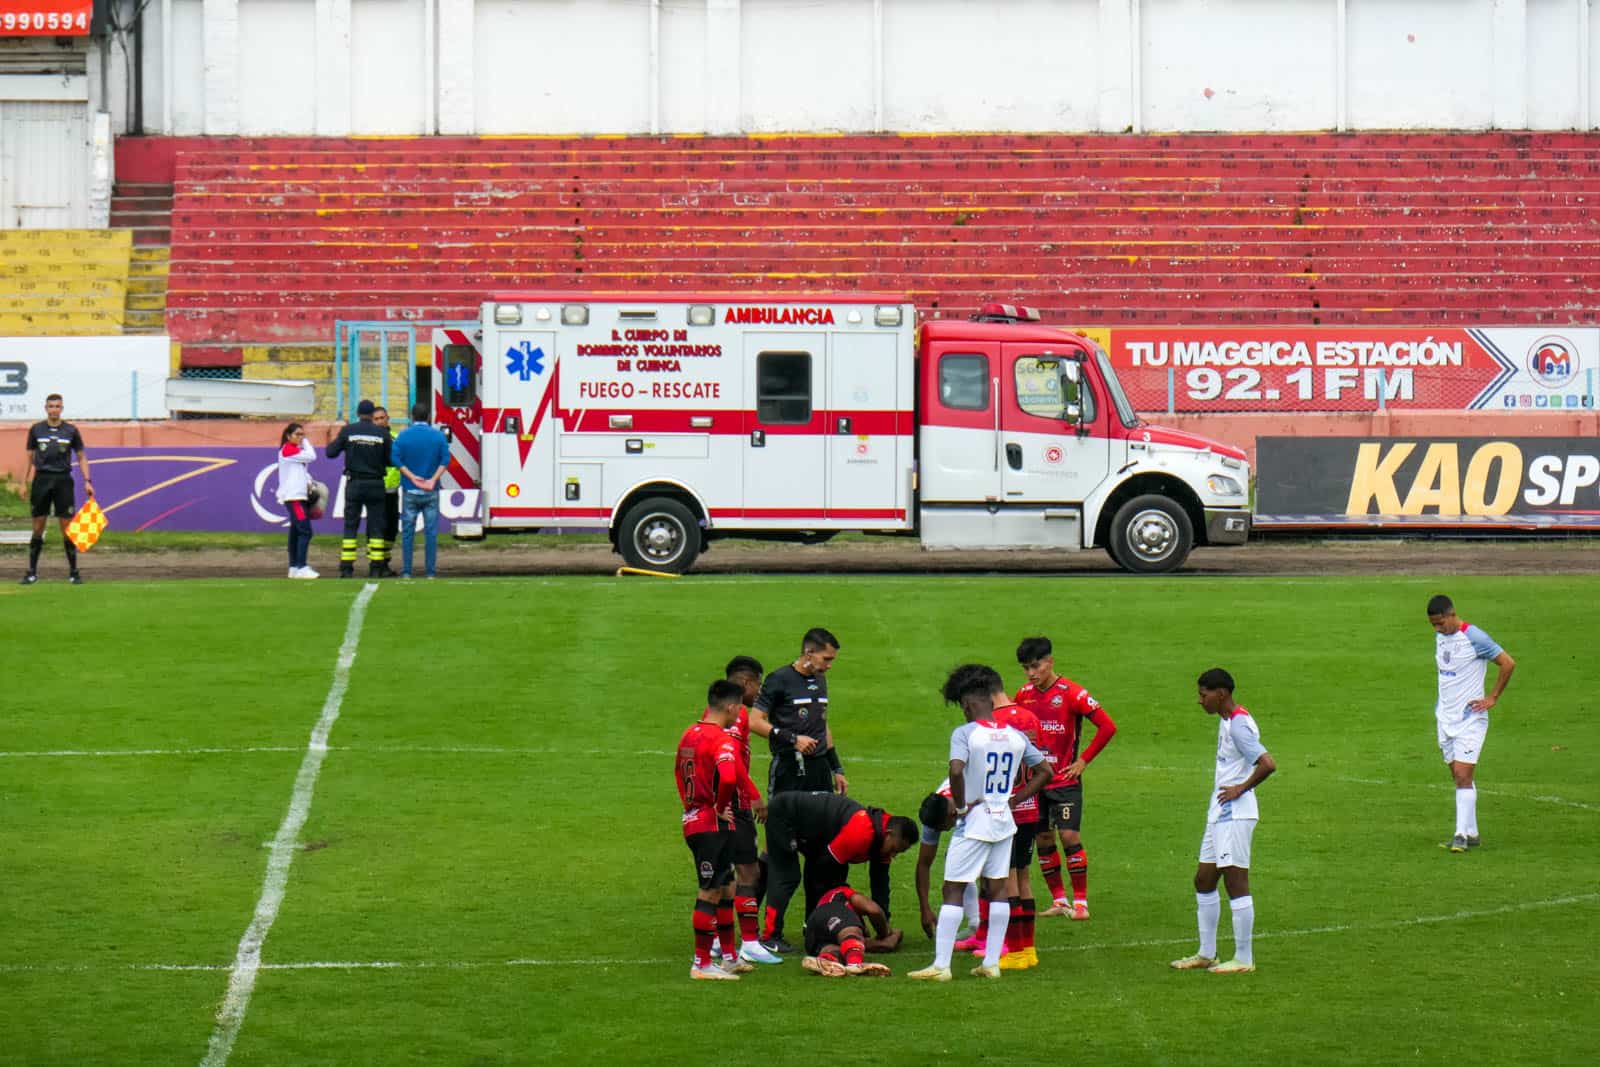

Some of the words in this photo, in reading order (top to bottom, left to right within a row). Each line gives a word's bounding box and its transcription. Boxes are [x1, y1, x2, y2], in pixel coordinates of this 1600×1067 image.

[0, 12, 87, 30] 990594
[725, 307, 835, 325] AMBULANCIA
[624, 329, 669, 341] CUERPO
[673, 329, 688, 341] DE
[577, 344, 639, 356] BOMBEROS
[643, 344, 722, 357] VOLUNTARIOS
[1125, 341, 1169, 367] TU
[1173, 341, 1313, 367] MAGGICA
[1316, 336, 1463, 367] ESTACIÓN
[617, 359, 631, 371] DE
[636, 359, 681, 372] CUENCA
[580, 382, 634, 398] FUEGO
[652, 382, 720, 398] RESCATE
[1186, 367, 1313, 401] 92.1
[1324, 367, 1415, 401] FM
[1143, 431, 1151, 442] 3
[1345, 441, 1524, 516] KAO
[1523, 455, 1600, 507] SP
[984, 751, 1014, 794] 23
[1062, 806, 1071, 820] 8
